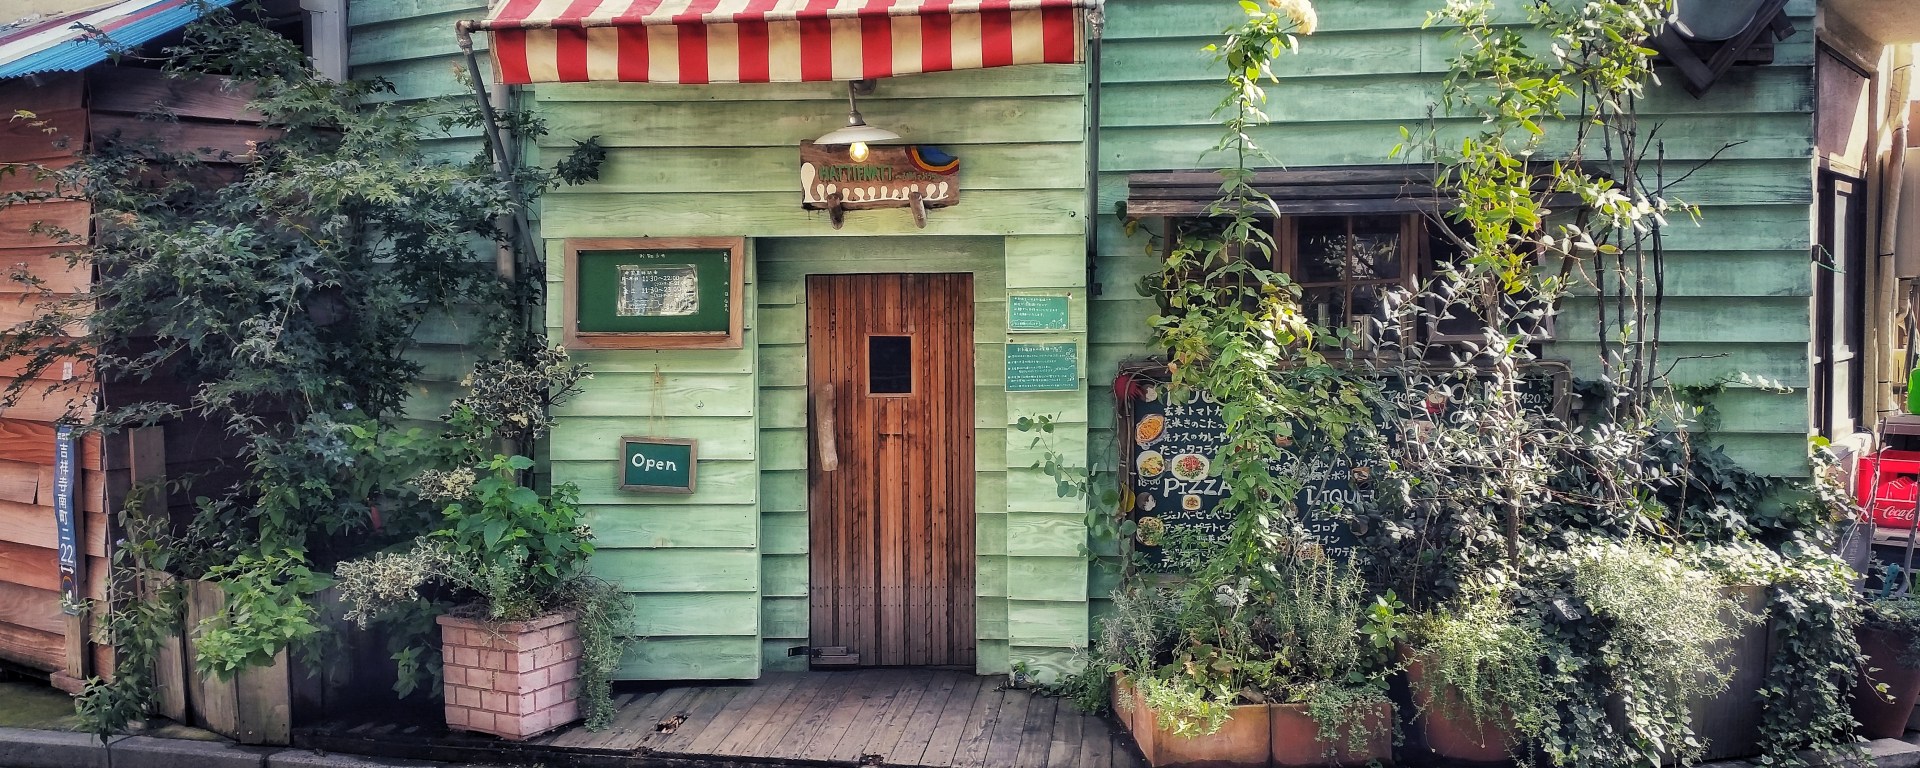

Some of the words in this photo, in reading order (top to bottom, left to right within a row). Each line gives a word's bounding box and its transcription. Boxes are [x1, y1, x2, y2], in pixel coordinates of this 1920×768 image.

[631, 453, 677, 472] Open
[1163, 478, 1233, 498] PIZZA
[1312, 521, 1340, 533] コロナ
[61, 544, 74, 564] 22
